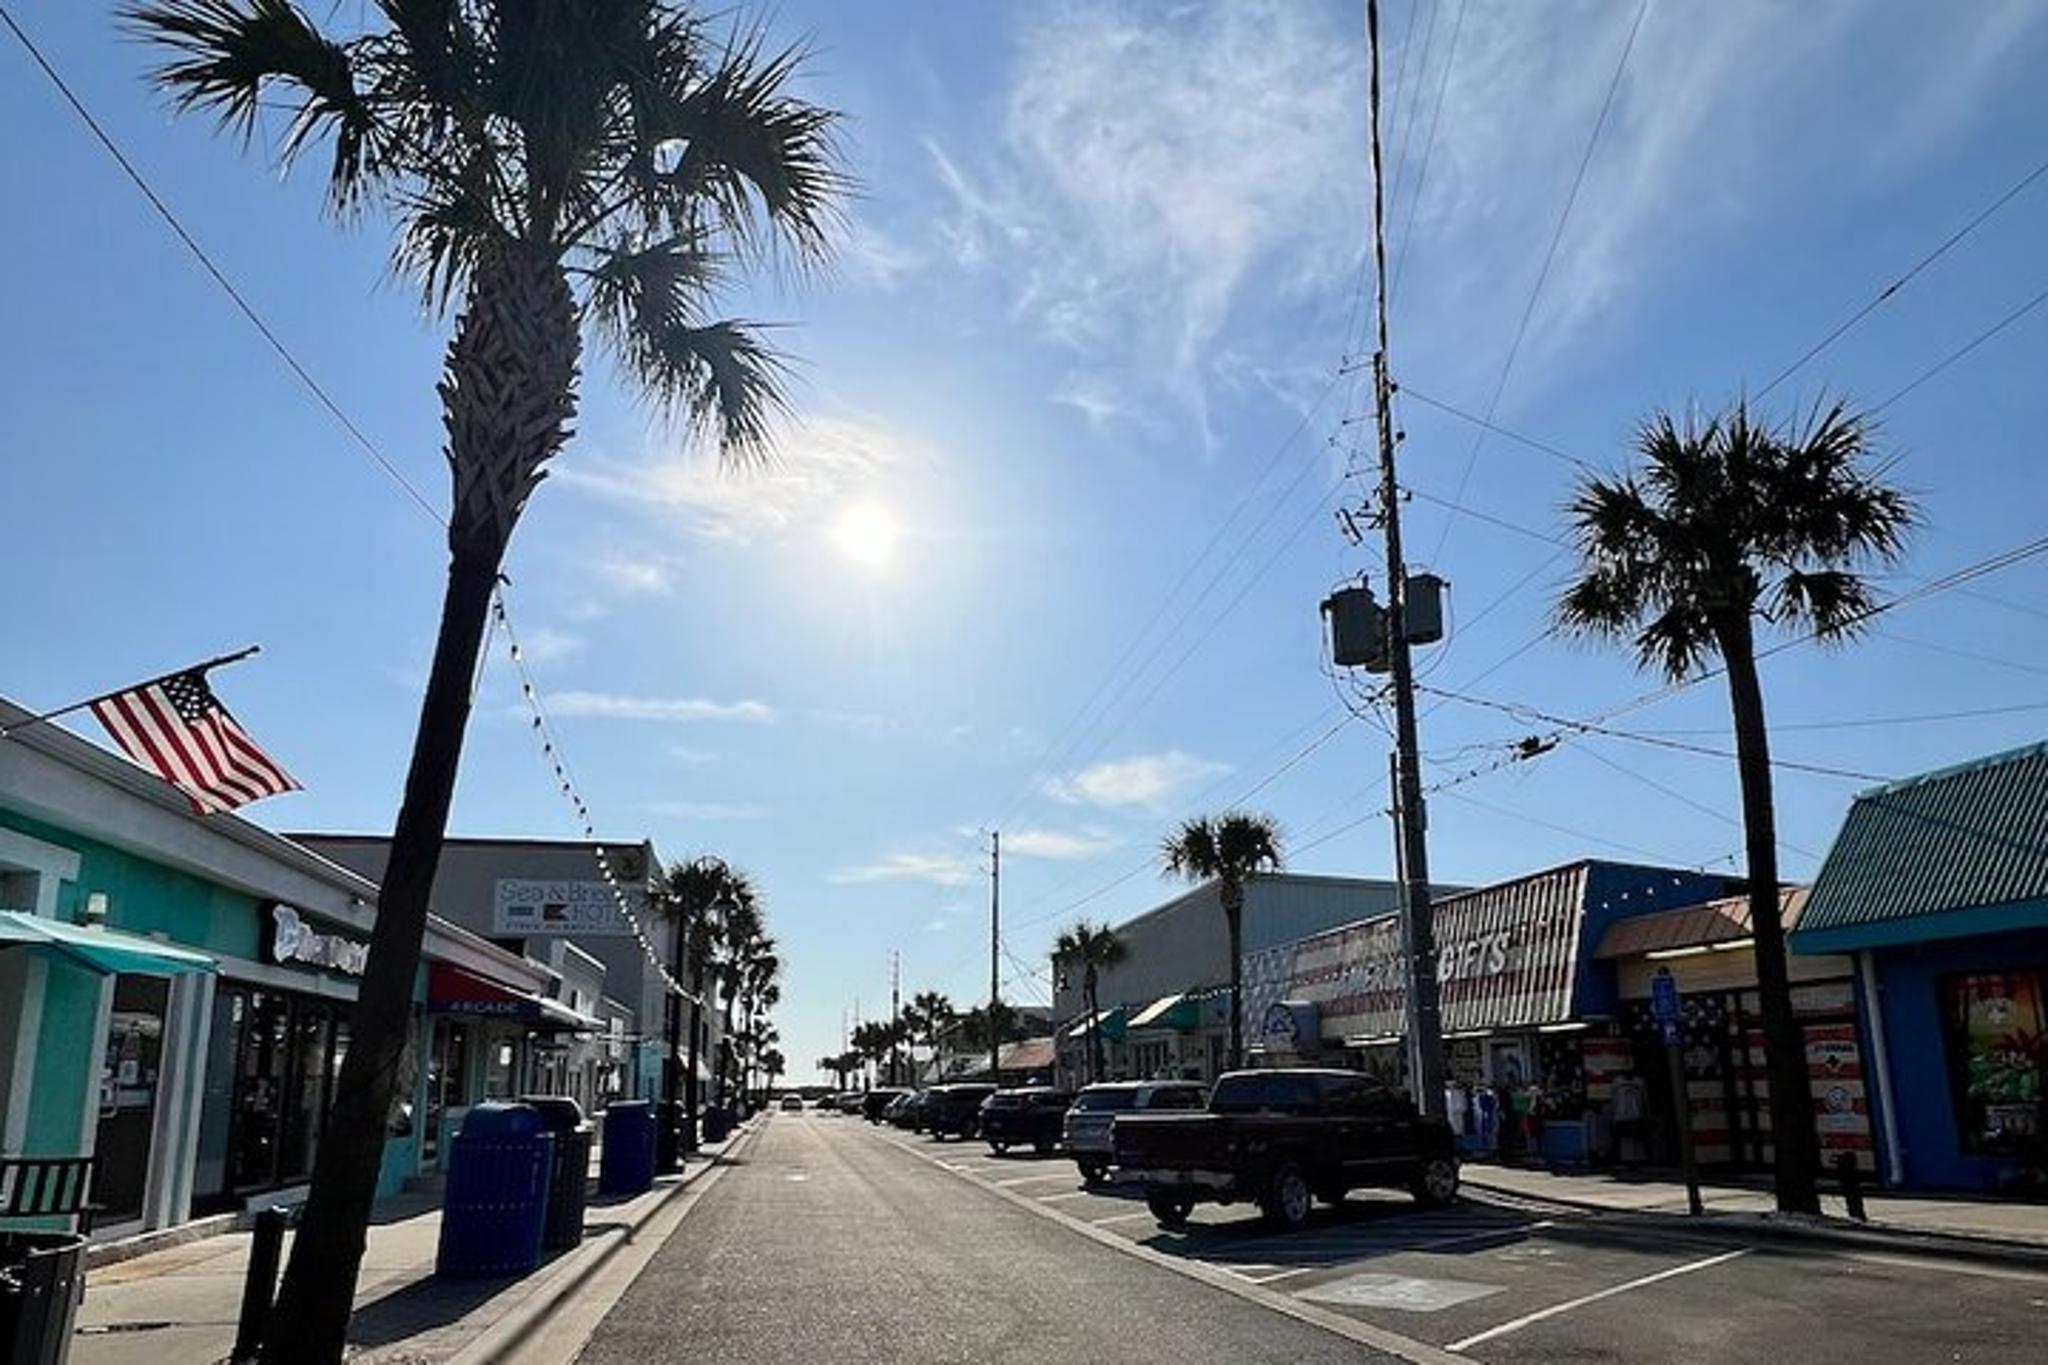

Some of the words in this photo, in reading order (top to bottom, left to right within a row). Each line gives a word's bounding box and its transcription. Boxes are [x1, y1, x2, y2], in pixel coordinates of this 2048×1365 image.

[501, 880, 544, 901] Sea
[573, 904, 631, 922] HOTE
[1437, 932, 1510, 983] GIFTS
[450, 1001, 519, 1014] ARCADE
